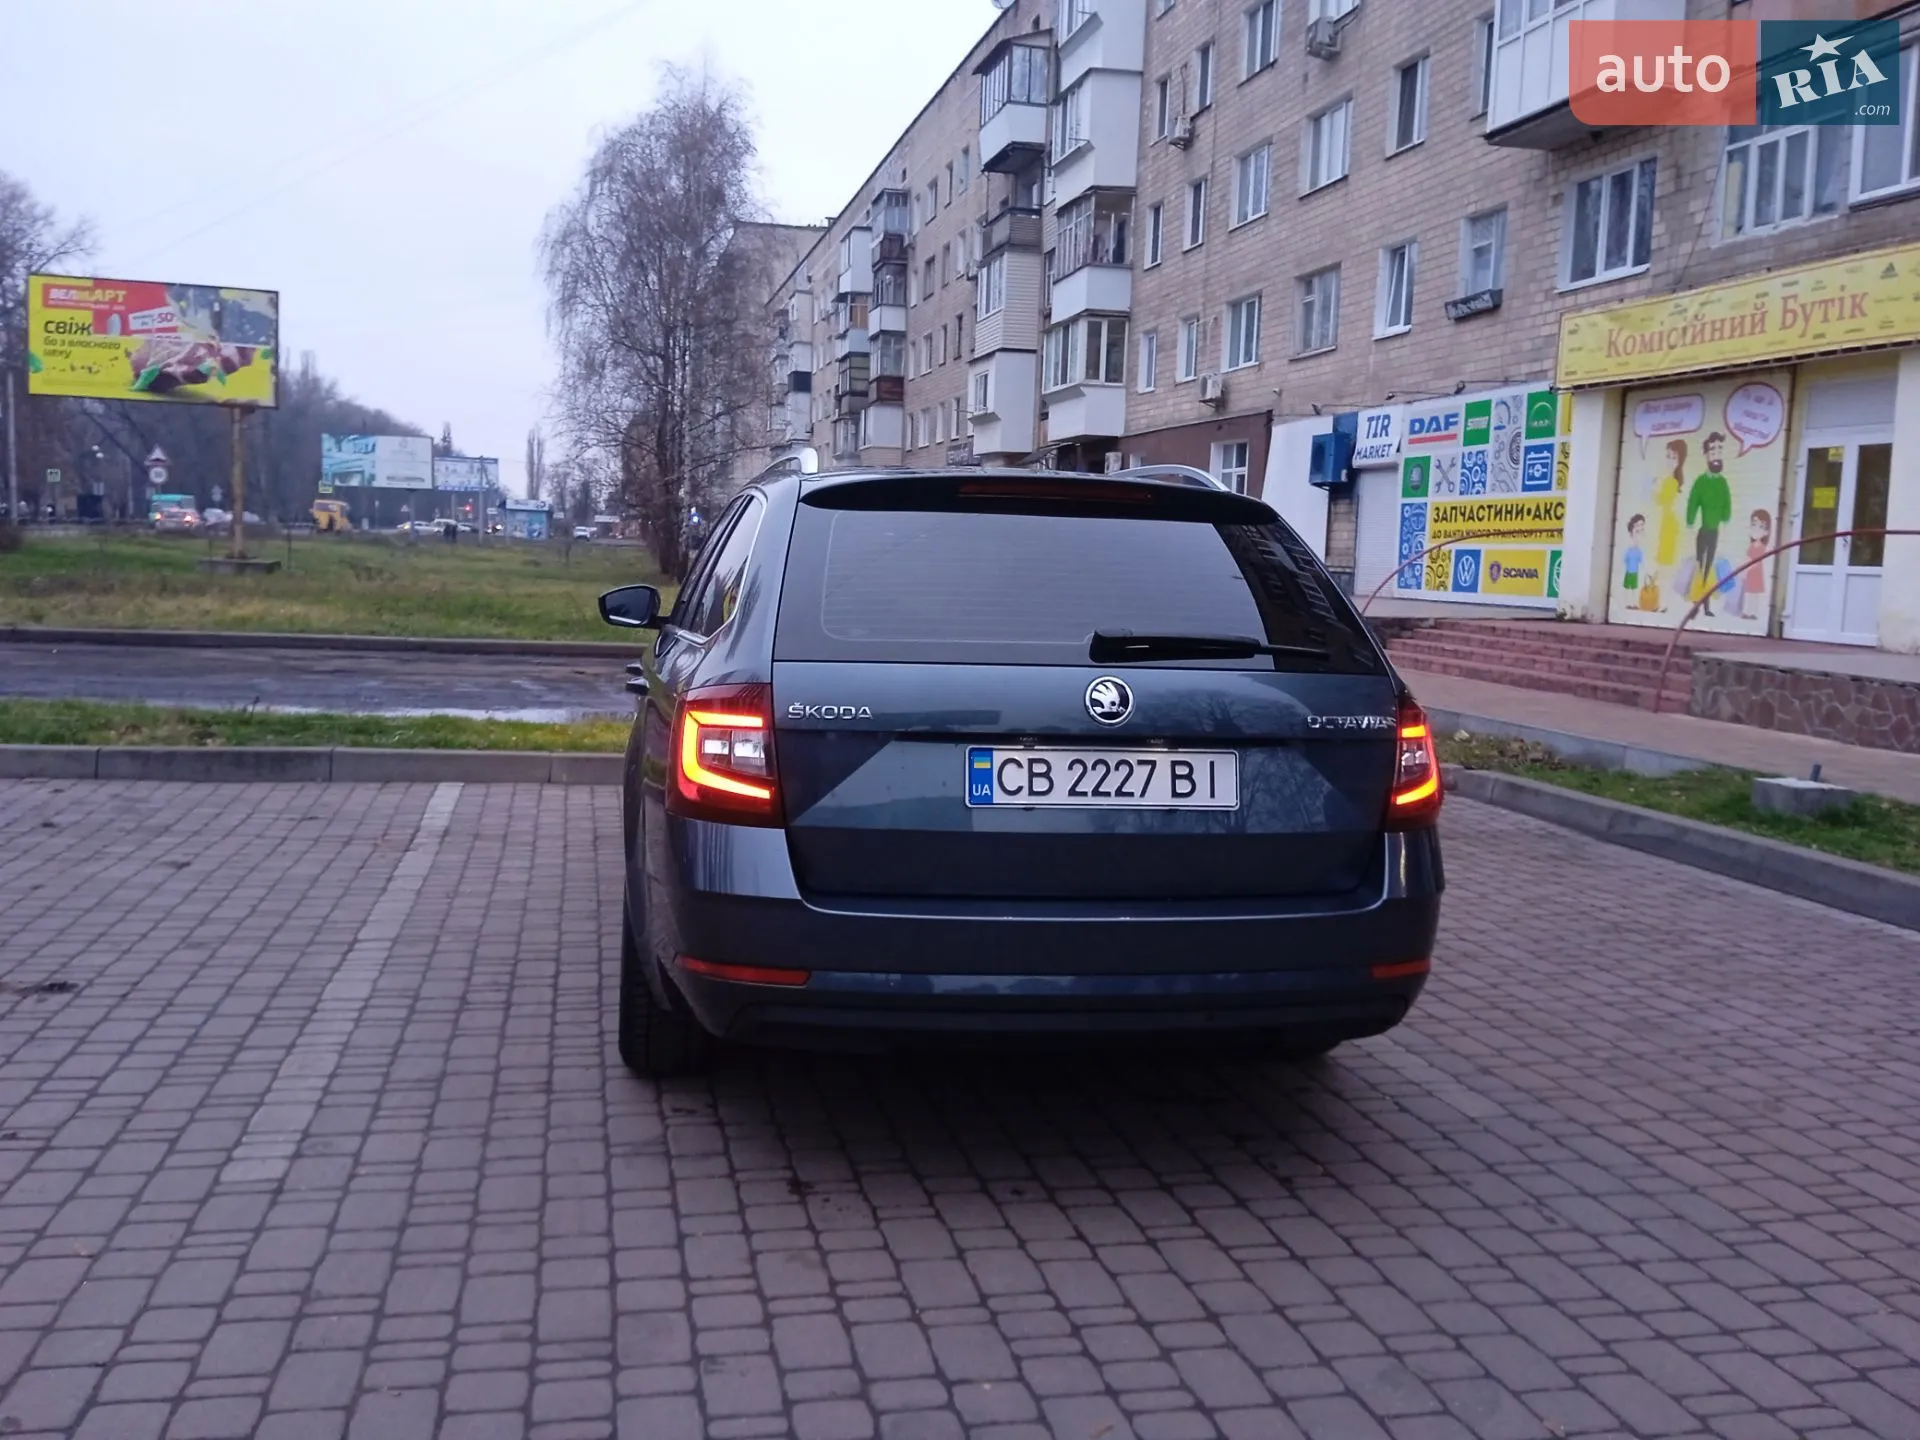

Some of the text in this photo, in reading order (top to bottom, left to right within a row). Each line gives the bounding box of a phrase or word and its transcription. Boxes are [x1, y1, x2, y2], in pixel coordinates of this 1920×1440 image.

[1605, 284, 1869, 358] Комісійний Бутік
[1366, 414, 1391, 439] TIR
[1409, 412, 1459, 436] DAF
[1354, 443, 1392, 460] MARKET
[1503, 567, 1538, 579] SCANIA
[788, 702, 873, 719] ŠKODA
[1307, 715, 1390, 729] OCTAVIA
[973, 784, 991, 797] UA
[997, 757, 1054, 797] CB
[1067, 758, 1157, 798] 2227
